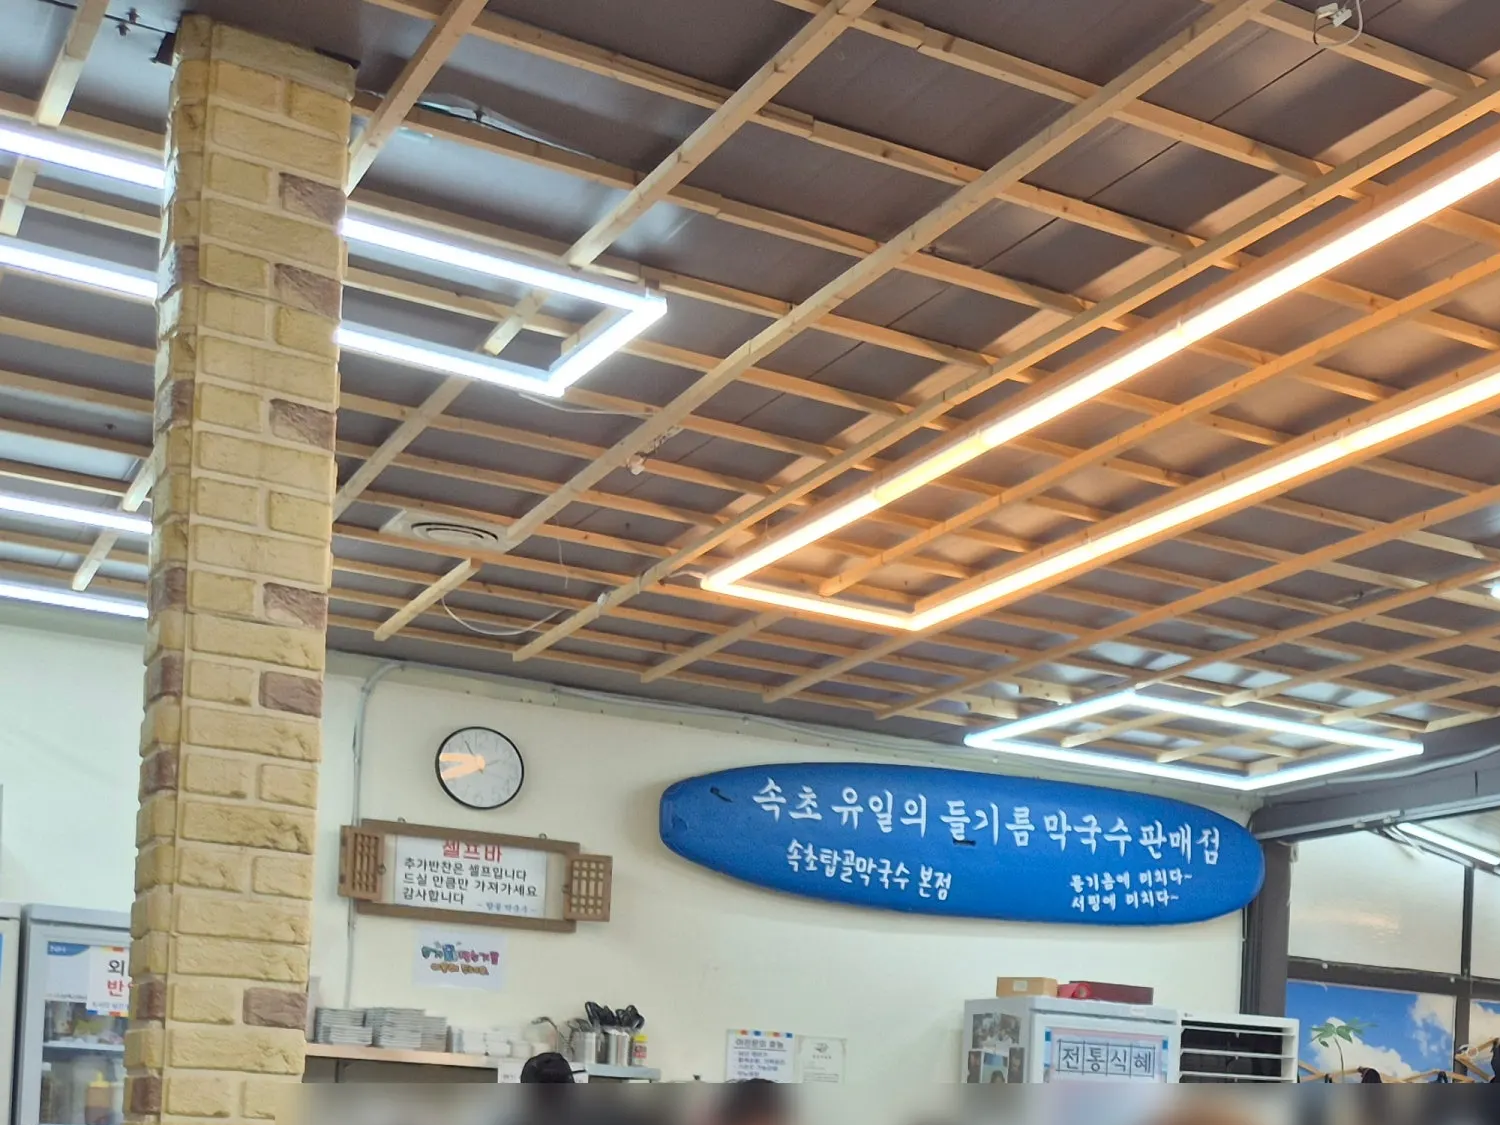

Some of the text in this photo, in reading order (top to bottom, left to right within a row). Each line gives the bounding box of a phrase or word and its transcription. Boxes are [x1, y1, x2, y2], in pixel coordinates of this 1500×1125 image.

[752, 776, 1221, 866] 속초 유일의 들기름 막국수 판매점
[442, 839, 503, 863] 셀프바
[404, 857, 527, 882] 추가반찬은 셀프입니다
[786, 838, 952, 901] 속초탑골막국수 본점
[403, 872, 538, 898] 드실 만큼만 가져가세요
[403, 886, 465, 905] 감사합니다
[1070, 892, 1117, 913] 서핑에
[1062, 1045, 1152, 1074] 전통식혜
